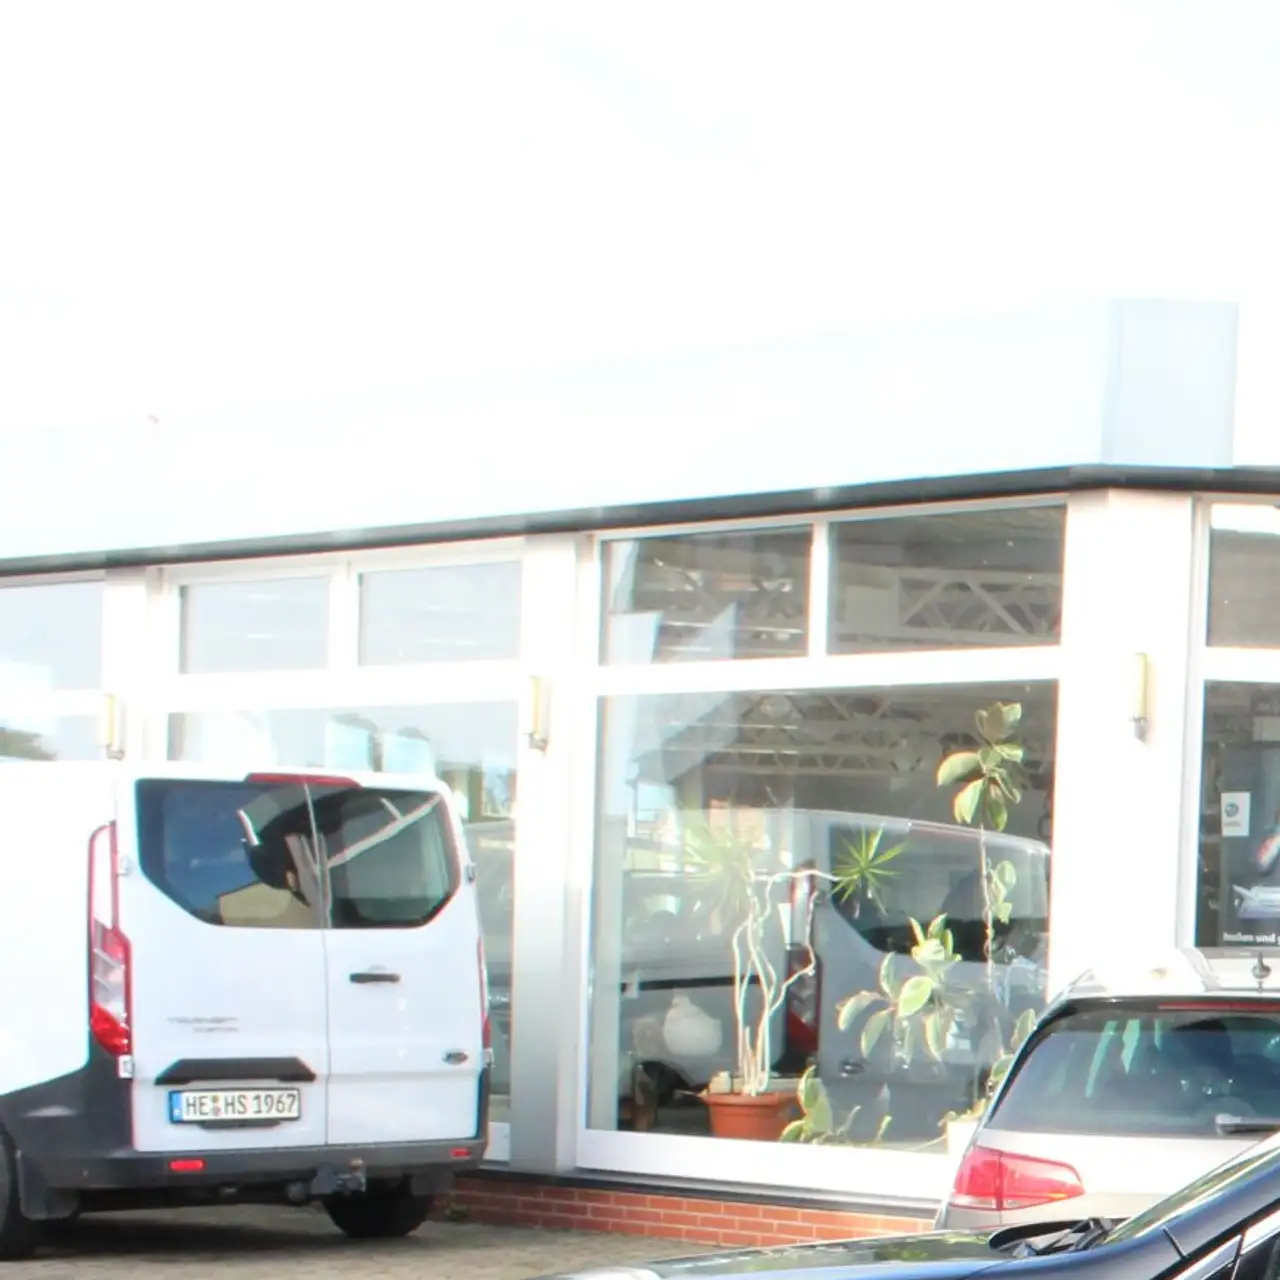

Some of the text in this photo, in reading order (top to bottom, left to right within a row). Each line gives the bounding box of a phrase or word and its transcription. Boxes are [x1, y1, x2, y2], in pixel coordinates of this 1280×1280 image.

[186, 1092, 297, 1115] HE HS 1967
